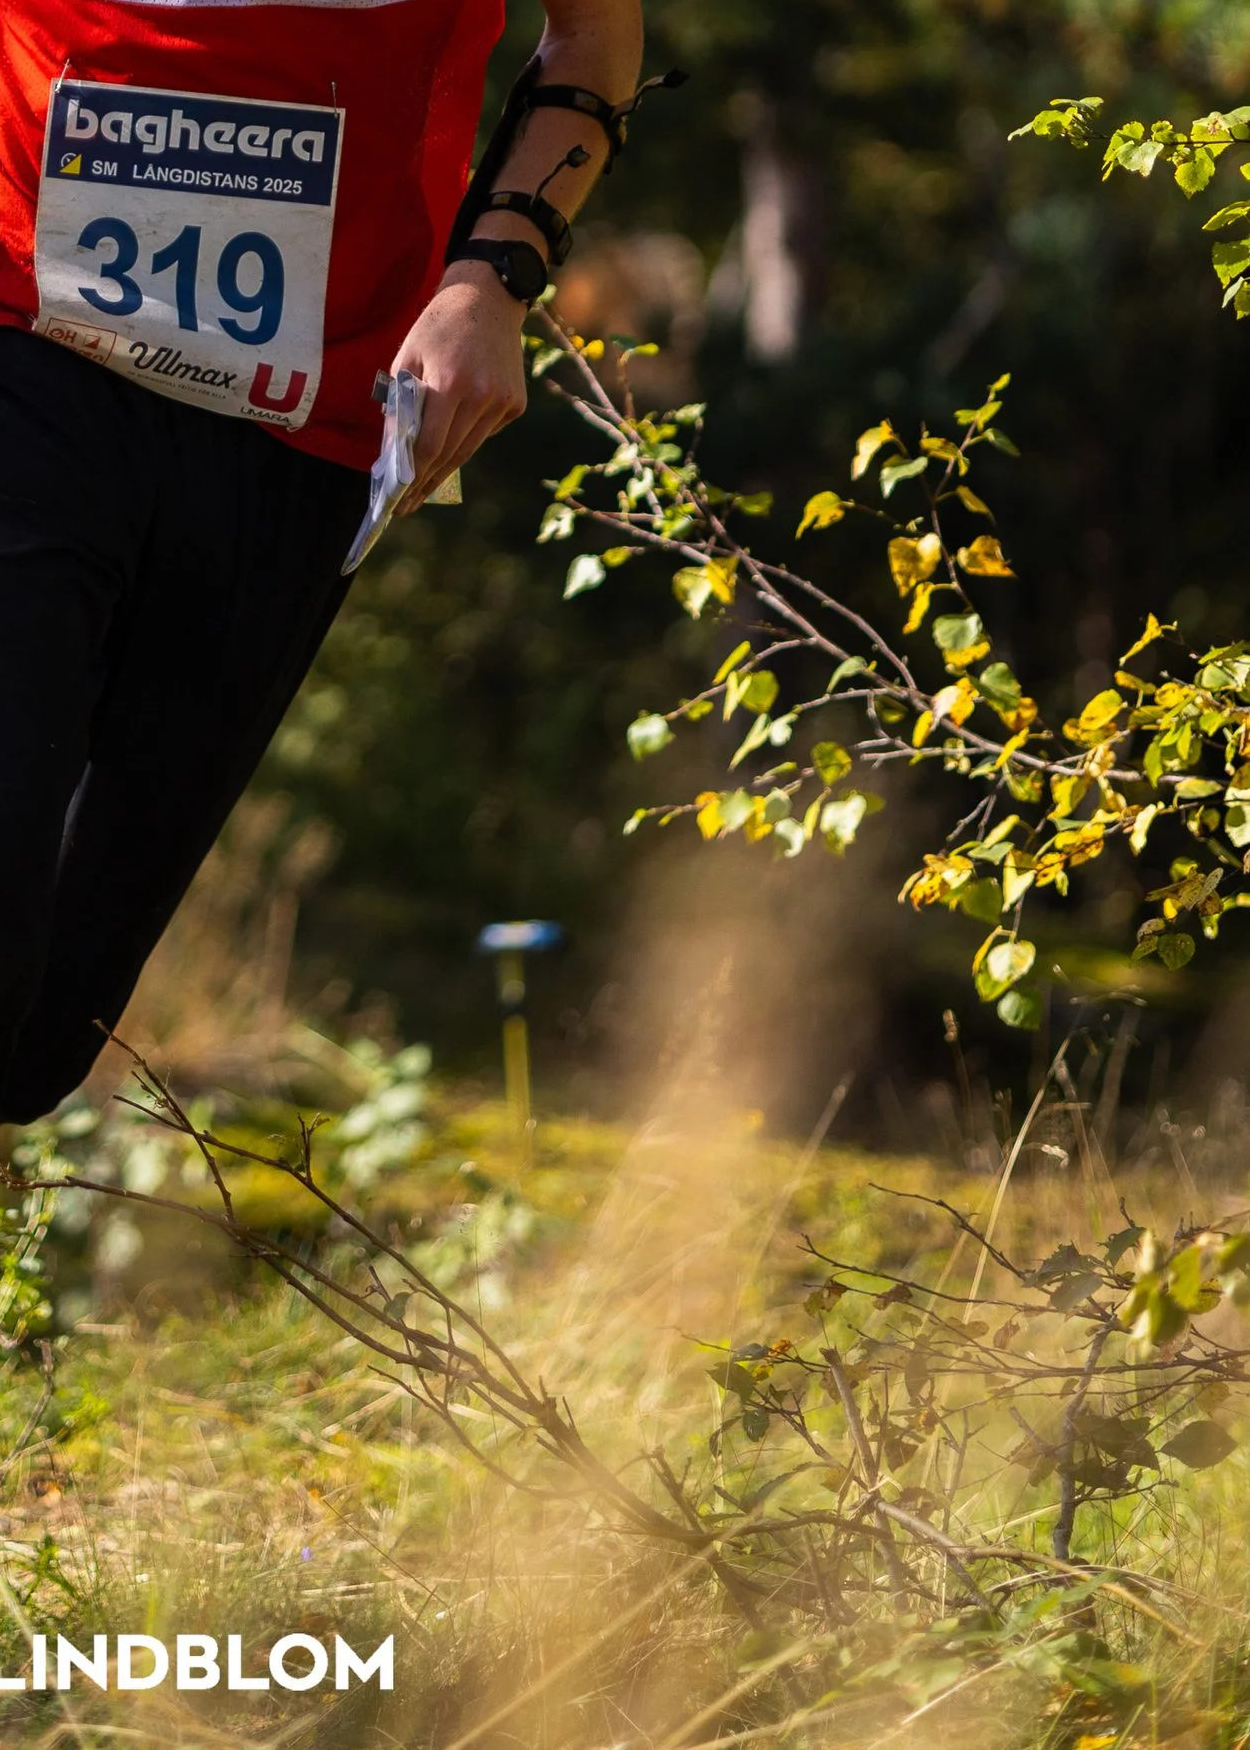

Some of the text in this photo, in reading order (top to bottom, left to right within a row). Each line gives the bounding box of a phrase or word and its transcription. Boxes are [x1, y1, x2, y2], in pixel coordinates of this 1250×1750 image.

[64, 98, 326, 163] bagheera
[91, 160, 303, 195] SM LÅNGDISTANS 2025
[76, 216, 285, 346] 319
[129, 341, 237, 388] Ullmax
[248, 361, 308, 414] U
[240, 406, 291, 424] UMARA
